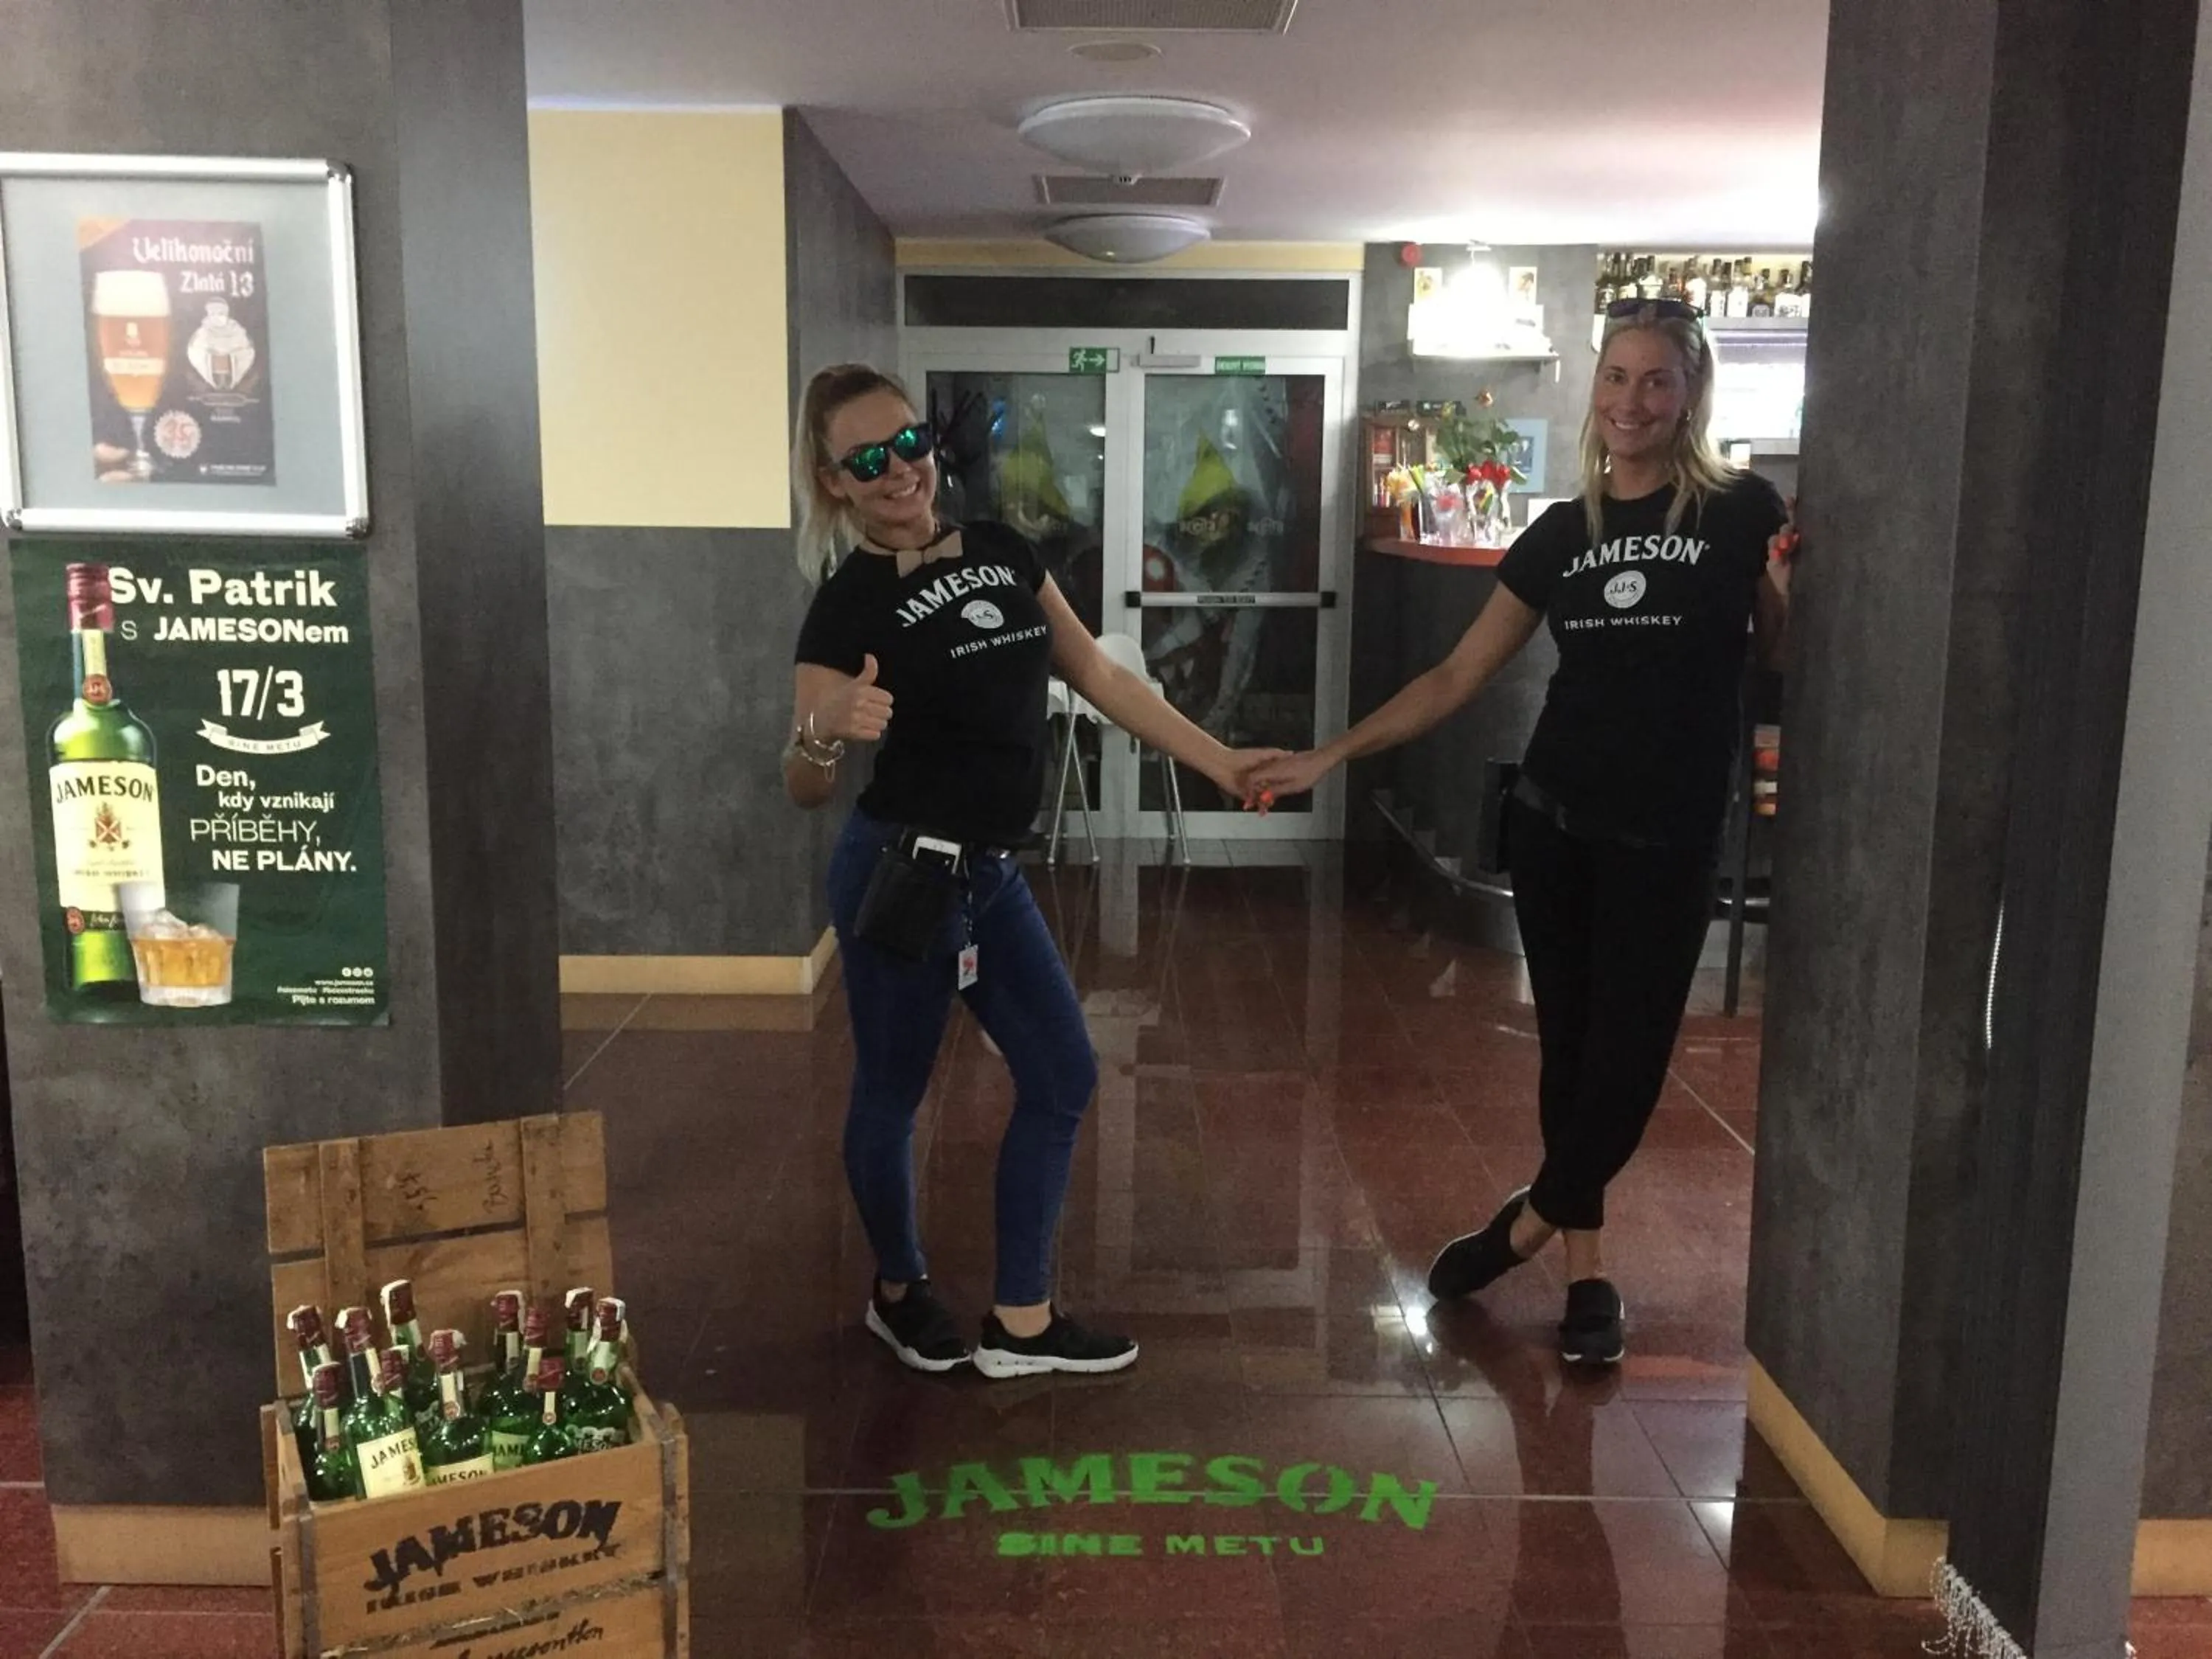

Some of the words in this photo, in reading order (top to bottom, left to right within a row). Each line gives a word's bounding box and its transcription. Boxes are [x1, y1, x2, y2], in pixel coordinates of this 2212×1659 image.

[181, 270, 225, 293] Zlatá
[229, 269, 254, 298] 13
[1562, 535, 1705, 577] JAMESON
[108, 567, 174, 605] Sv.
[189, 568, 337, 608] Patrik
[896, 565, 1018, 627] JAMESON
[153, 616, 349, 644] JAMESONem
[1565, 619, 1605, 630] IRISH
[1610, 615, 1683, 627] WHISKEY
[950, 640, 988, 658] IRISH
[990, 625, 1048, 647] WHISKEY
[217, 666, 305, 721] 17/3
[56, 775, 153, 804] JAMESON
[196, 764, 257, 790] Den,
[218, 791, 253, 812] kdy
[260, 792, 335, 813] vznikají
[190, 813, 321, 846] PŘÍBĚHY,
[212, 850, 249, 872] NE
[257, 845, 357, 872] PLÁNY.
[865, 1453, 1438, 1531] JAMESON
[364, 1499, 622, 1593] JAMESON
[1166, 1534, 1324, 1556] METU
